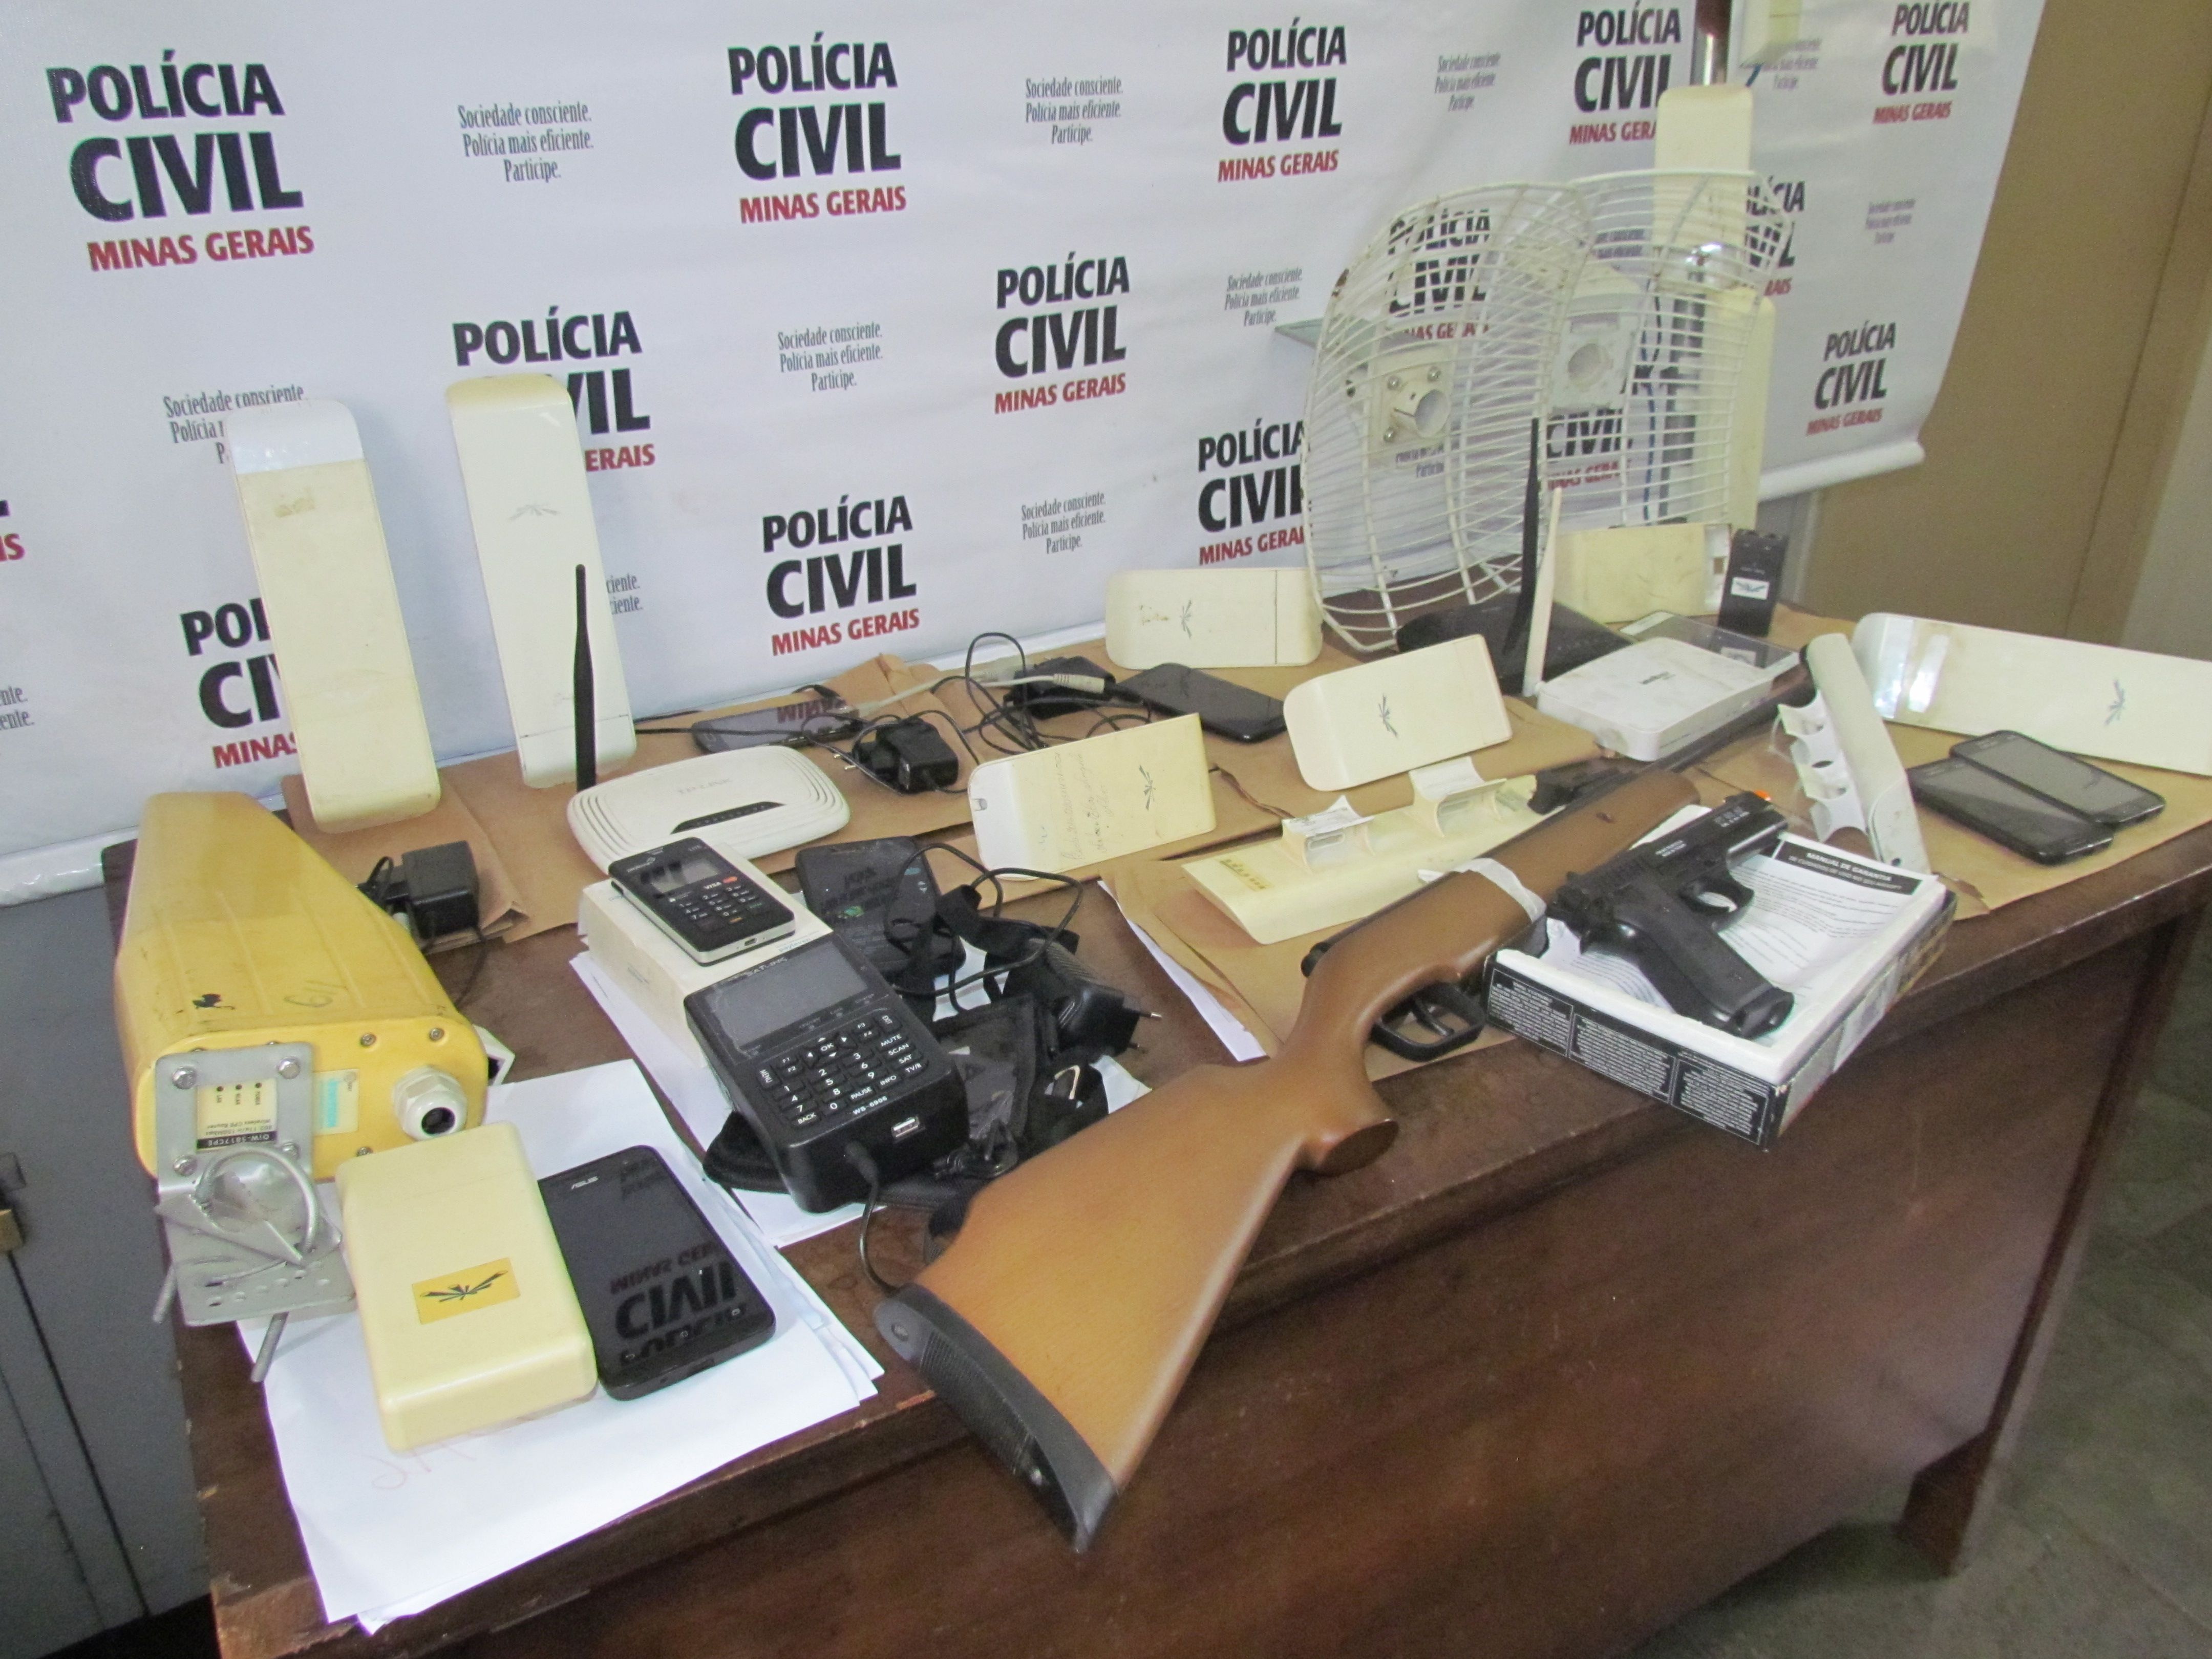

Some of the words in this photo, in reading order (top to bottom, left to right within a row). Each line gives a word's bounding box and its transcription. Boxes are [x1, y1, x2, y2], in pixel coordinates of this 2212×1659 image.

[1577, 2, 1681, 47] POLÍCIA
[1227, 17, 1347, 72] POLÍCIA
[728, 32, 897, 95] POLÍCIA
[46, 49, 285, 122] POLÍCIA
[458, 102, 522, 128] Sociedade
[1223, 77, 1342, 145] CIVIL
[507, 131, 537, 154] mais
[735, 102, 901, 180] CIVIL
[70, 132, 304, 222] CIVIL
[504, 158, 561, 183] Participe.
[1218, 155, 1275, 182] MINAS
[1281, 149, 1338, 177] GERAIS
[740, 193, 819, 223] MINAS
[826, 186, 906, 216] GERAIS
[87, 235, 198, 271] MINAS
[205, 226, 315, 261] GERAIS
[996, 251, 1129, 309] POLÍCIA
[453, 305, 643, 366] POLÍCIA
[777, 327, 827, 350] Sociedade
[995, 305, 1126, 378] CIVIL
[816, 348, 839, 368] mais
[811, 369, 857, 392] Participe.
[994, 384, 1057, 414] MINAS
[1062, 373, 1125, 402] GERAIS
[163, 390, 232, 418] Sociedade
[170, 418, 218, 443] Polícia
[584, 443, 655, 472] ERAIS
[762, 494, 913, 553] POLÍCIA
[1199, 537, 1252, 565] MINAS
[1258, 523, 1305, 552] GERAI
[767, 543, 917, 619] CIVIL
[772, 623, 842, 656] MINAS
[847, 608, 920, 640] GERAIS
[821, 1043, 834, 1051] OK
[880, 1033, 902, 1047] MUTE
[888, 1043, 909, 1056] SCAN
[818, 1069, 827, 1077] 2
[899, 1054, 912, 1064] SAT
[759, 1069, 773, 1083] MENU
[867, 1071, 875, 1079] 9
[879, 1075, 897, 1086] INFO
[850, 1087, 873, 1100] PAUSE
[796, 1104, 803, 1112] 7
[798, 1112, 817, 1124] BACK
